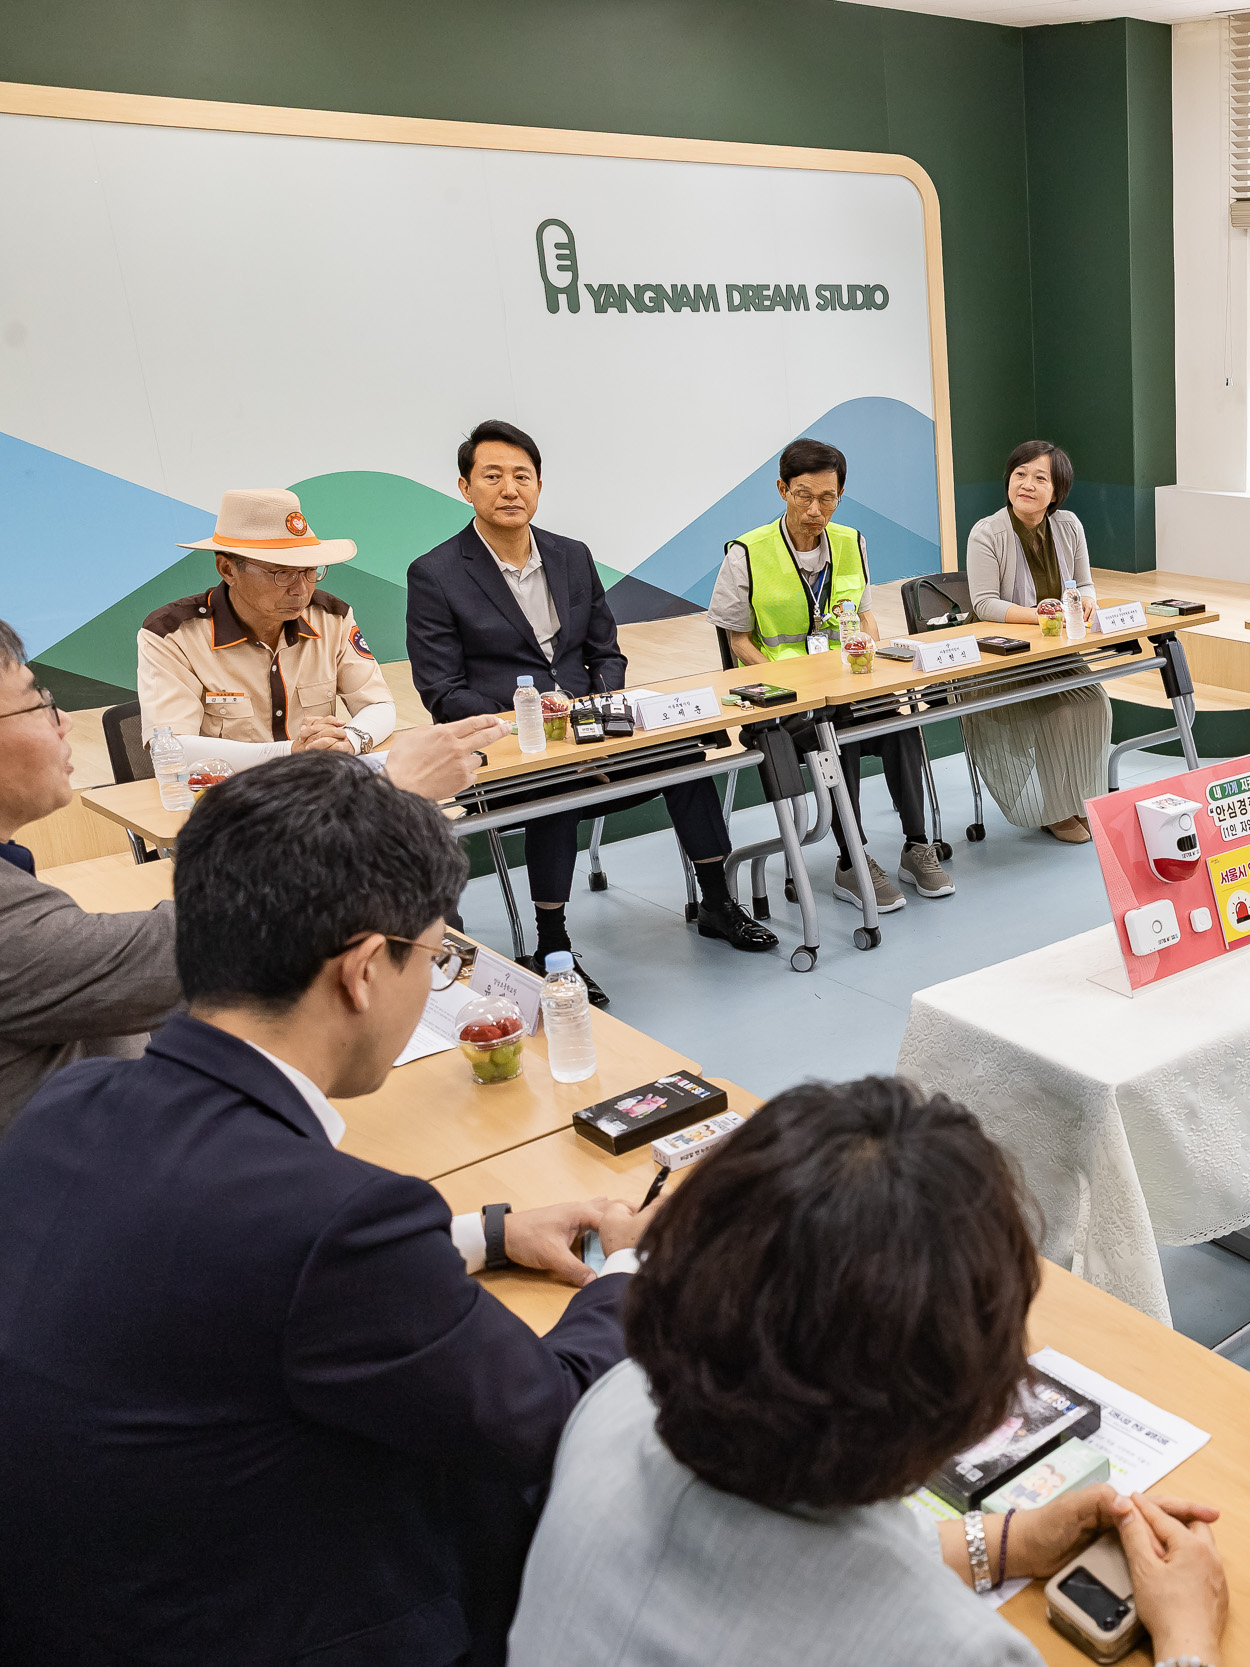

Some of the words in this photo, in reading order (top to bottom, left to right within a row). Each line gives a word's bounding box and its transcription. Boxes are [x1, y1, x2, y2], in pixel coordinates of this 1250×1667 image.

[584, 283, 721, 314] YANGNAM
[726, 284, 811, 313] DREAM
[815, 283, 890, 312] STUDIO
[1213, 785, 1223, 799] 내
[1223, 781, 1239, 796] 가게
[1220, 864, 1248, 885] 서울시
